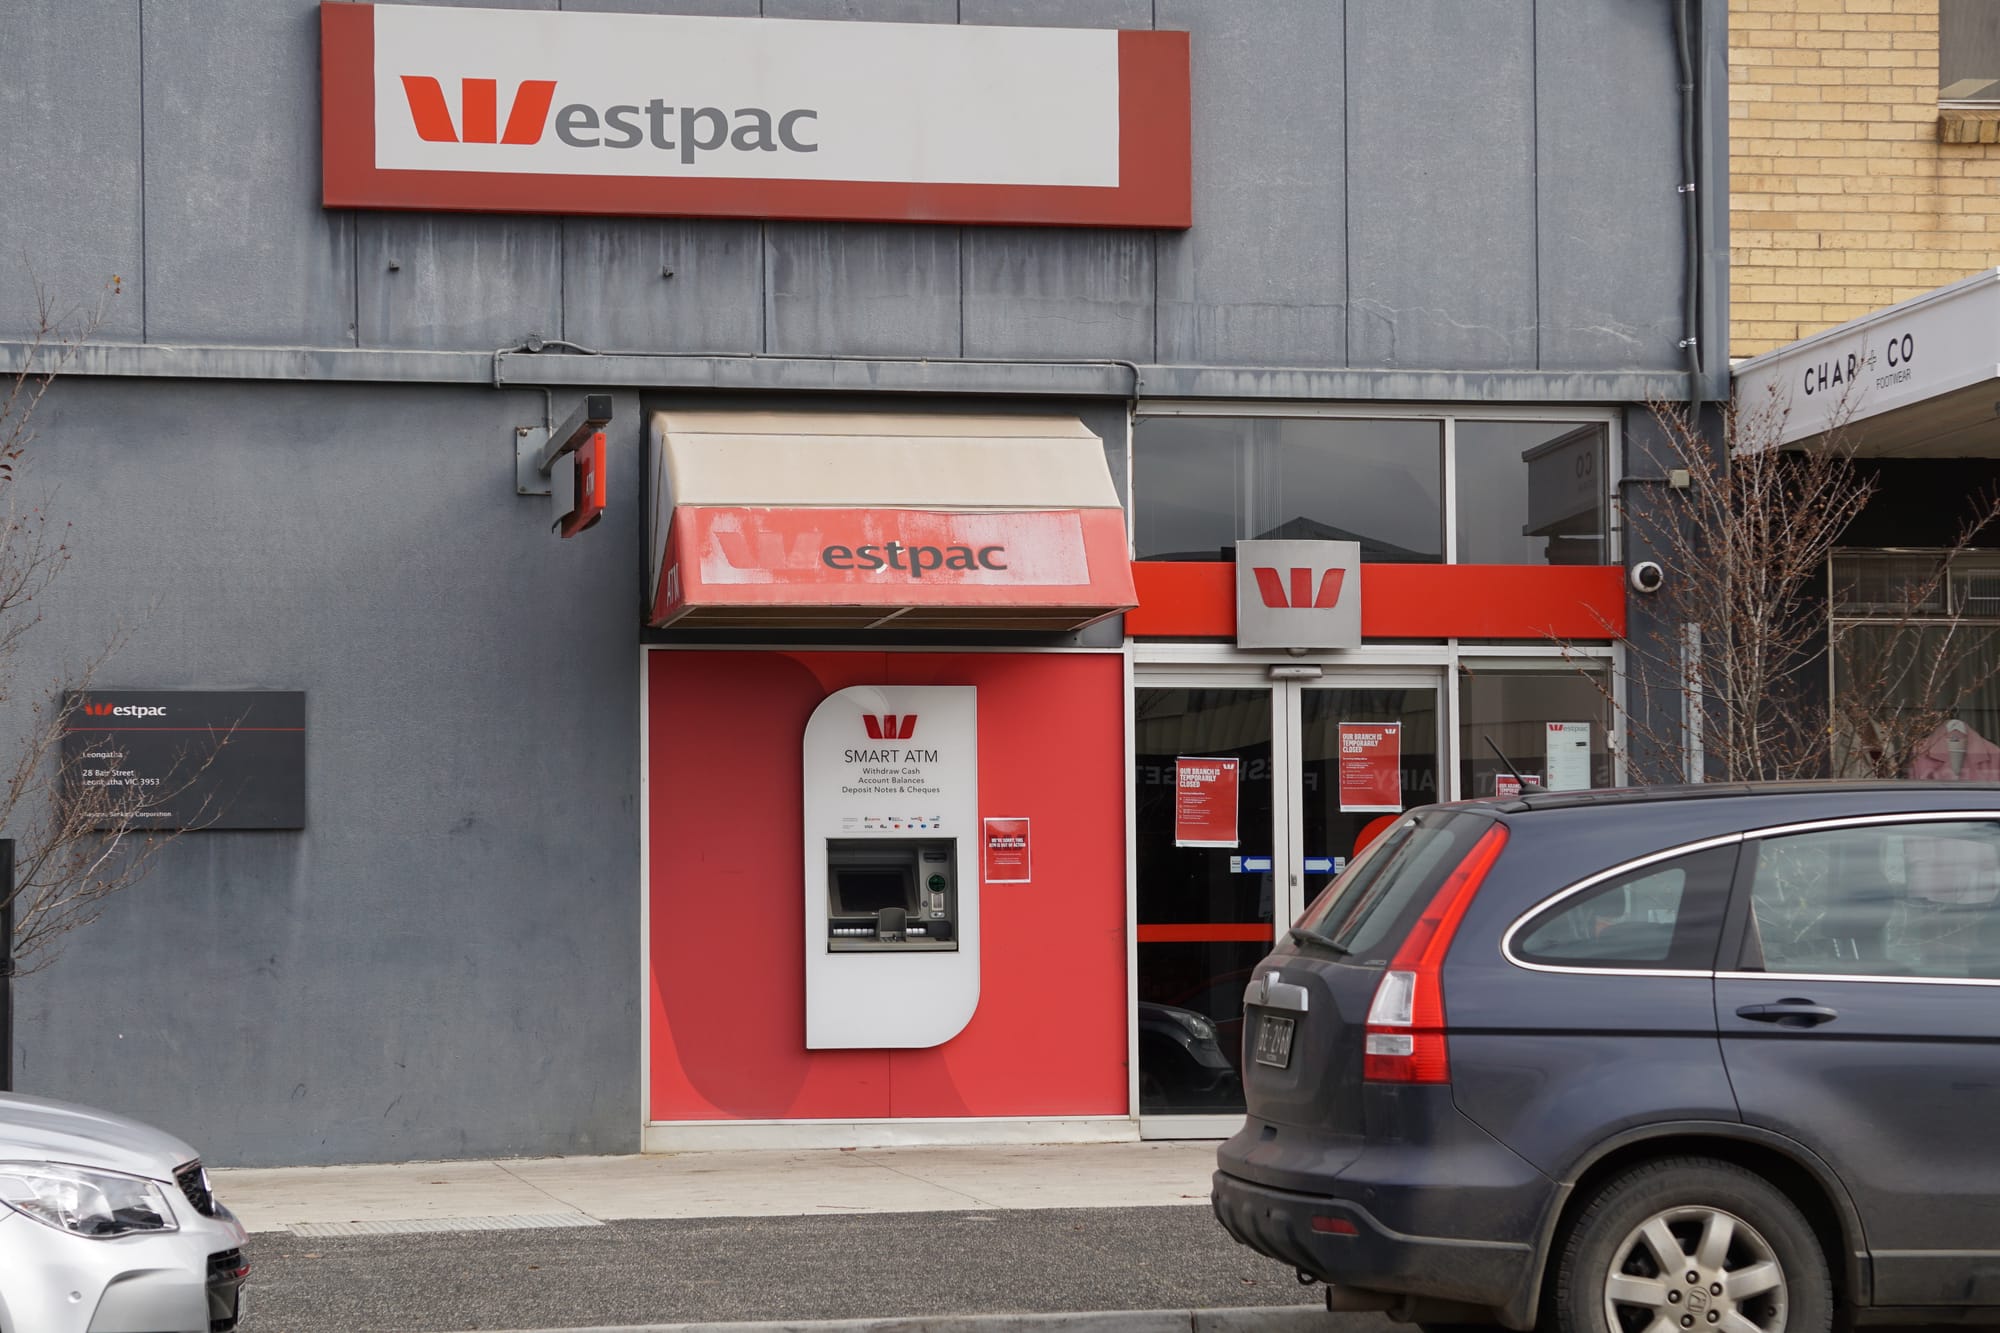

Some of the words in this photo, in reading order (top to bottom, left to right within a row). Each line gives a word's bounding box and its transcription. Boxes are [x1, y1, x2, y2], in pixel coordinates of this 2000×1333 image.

[399, 75, 819, 164] Westpac
[1804, 353, 1856, 396] CHAR
[1887, 333, 1914, 368] CO
[1876, 368, 1912, 390] FOOTWEAR
[84, 703, 167, 719] Westpac
[844, 749, 900, 763] SMART
[904, 749, 938, 763] ATM
[82, 769, 93, 777] 28
[112, 769, 135, 777] Street
[862, 767, 900, 775] Withdraw
[901, 767, 921, 775] Cash
[124, 778, 139, 786] VIC
[140, 778, 160, 786] 3953
[1180, 774, 1216, 782] TEMPORARILY
[841, 786, 872, 795] Deposit
[906, 786, 941, 795] Cheques
